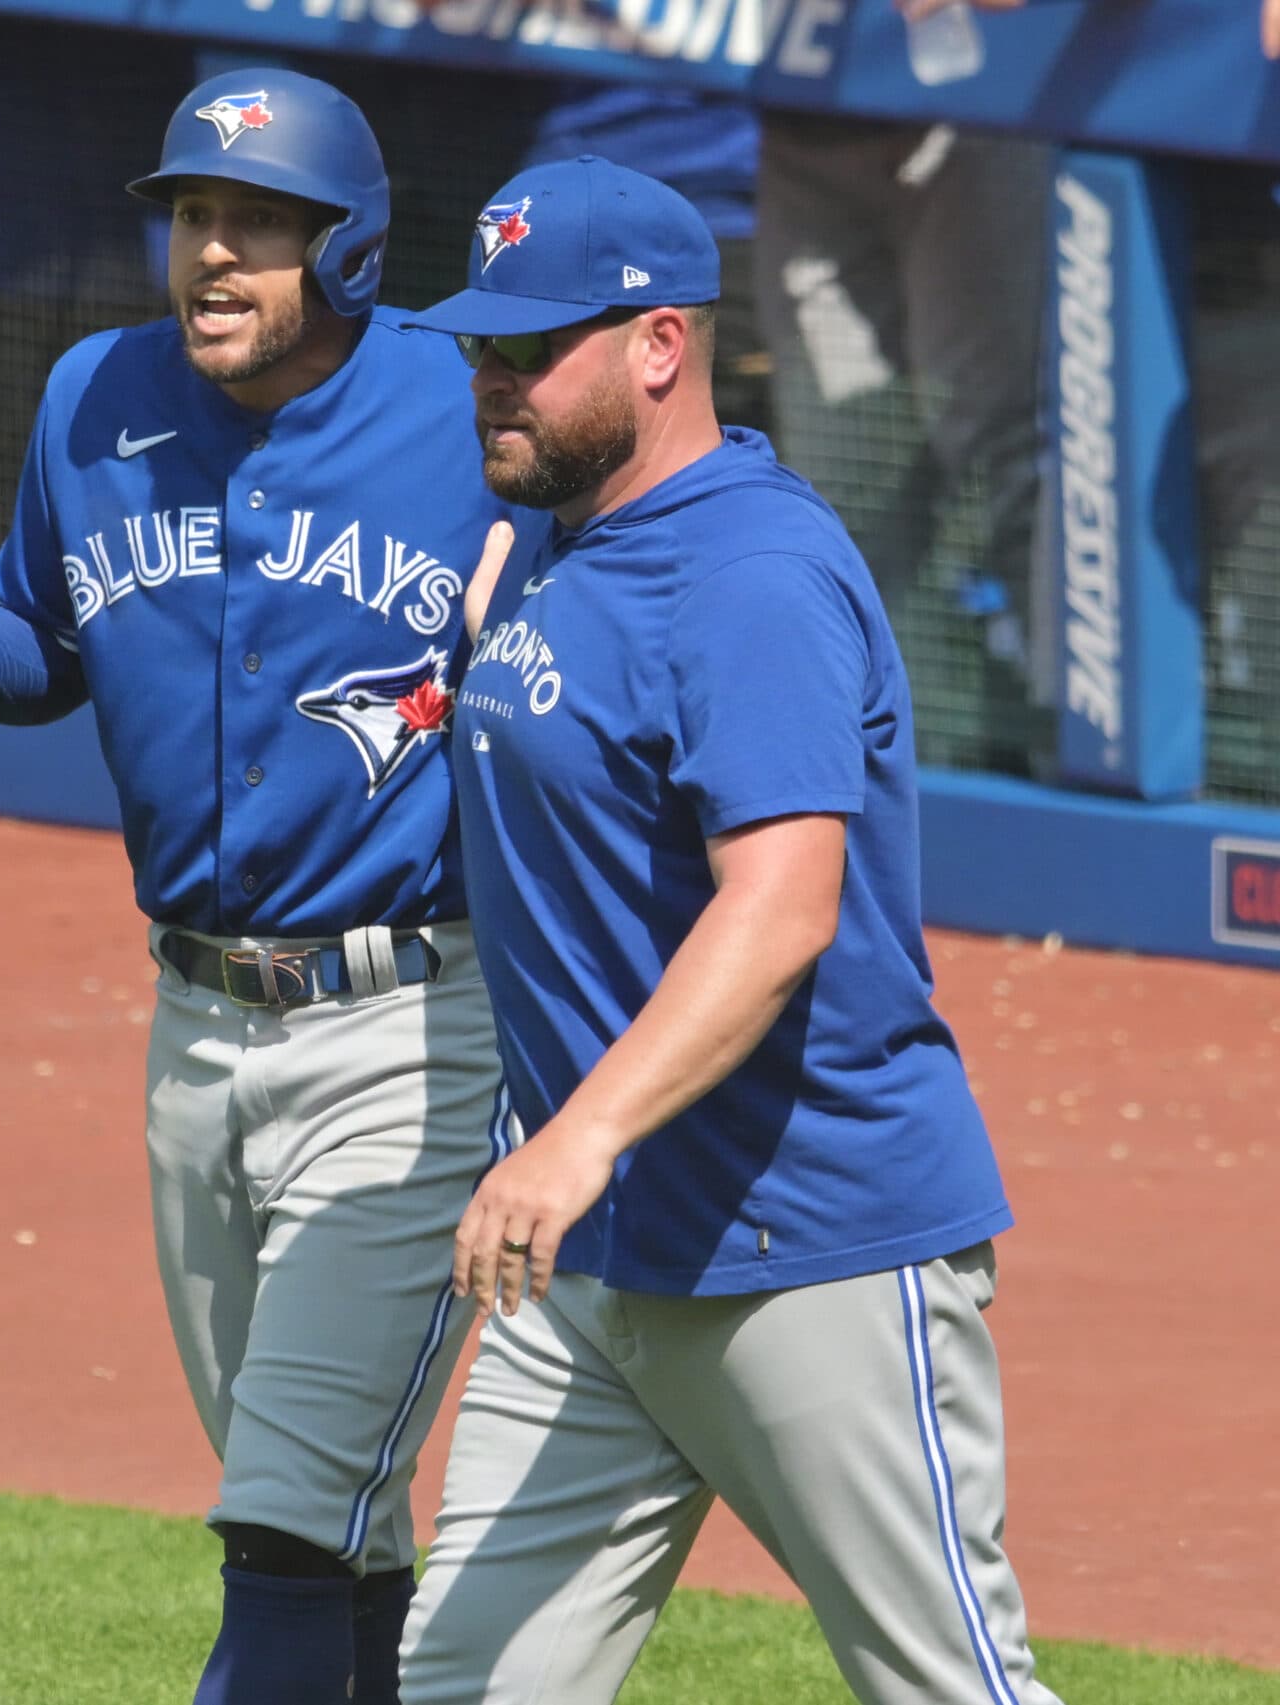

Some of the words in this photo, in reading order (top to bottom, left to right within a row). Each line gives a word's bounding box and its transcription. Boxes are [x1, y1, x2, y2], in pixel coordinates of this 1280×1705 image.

[1055, 172, 1122, 740] PROGRESSIVE
[62, 506, 221, 630] BLUE
[256, 509, 463, 636] JAYS
[462, 690, 515, 720] BASEBALL
